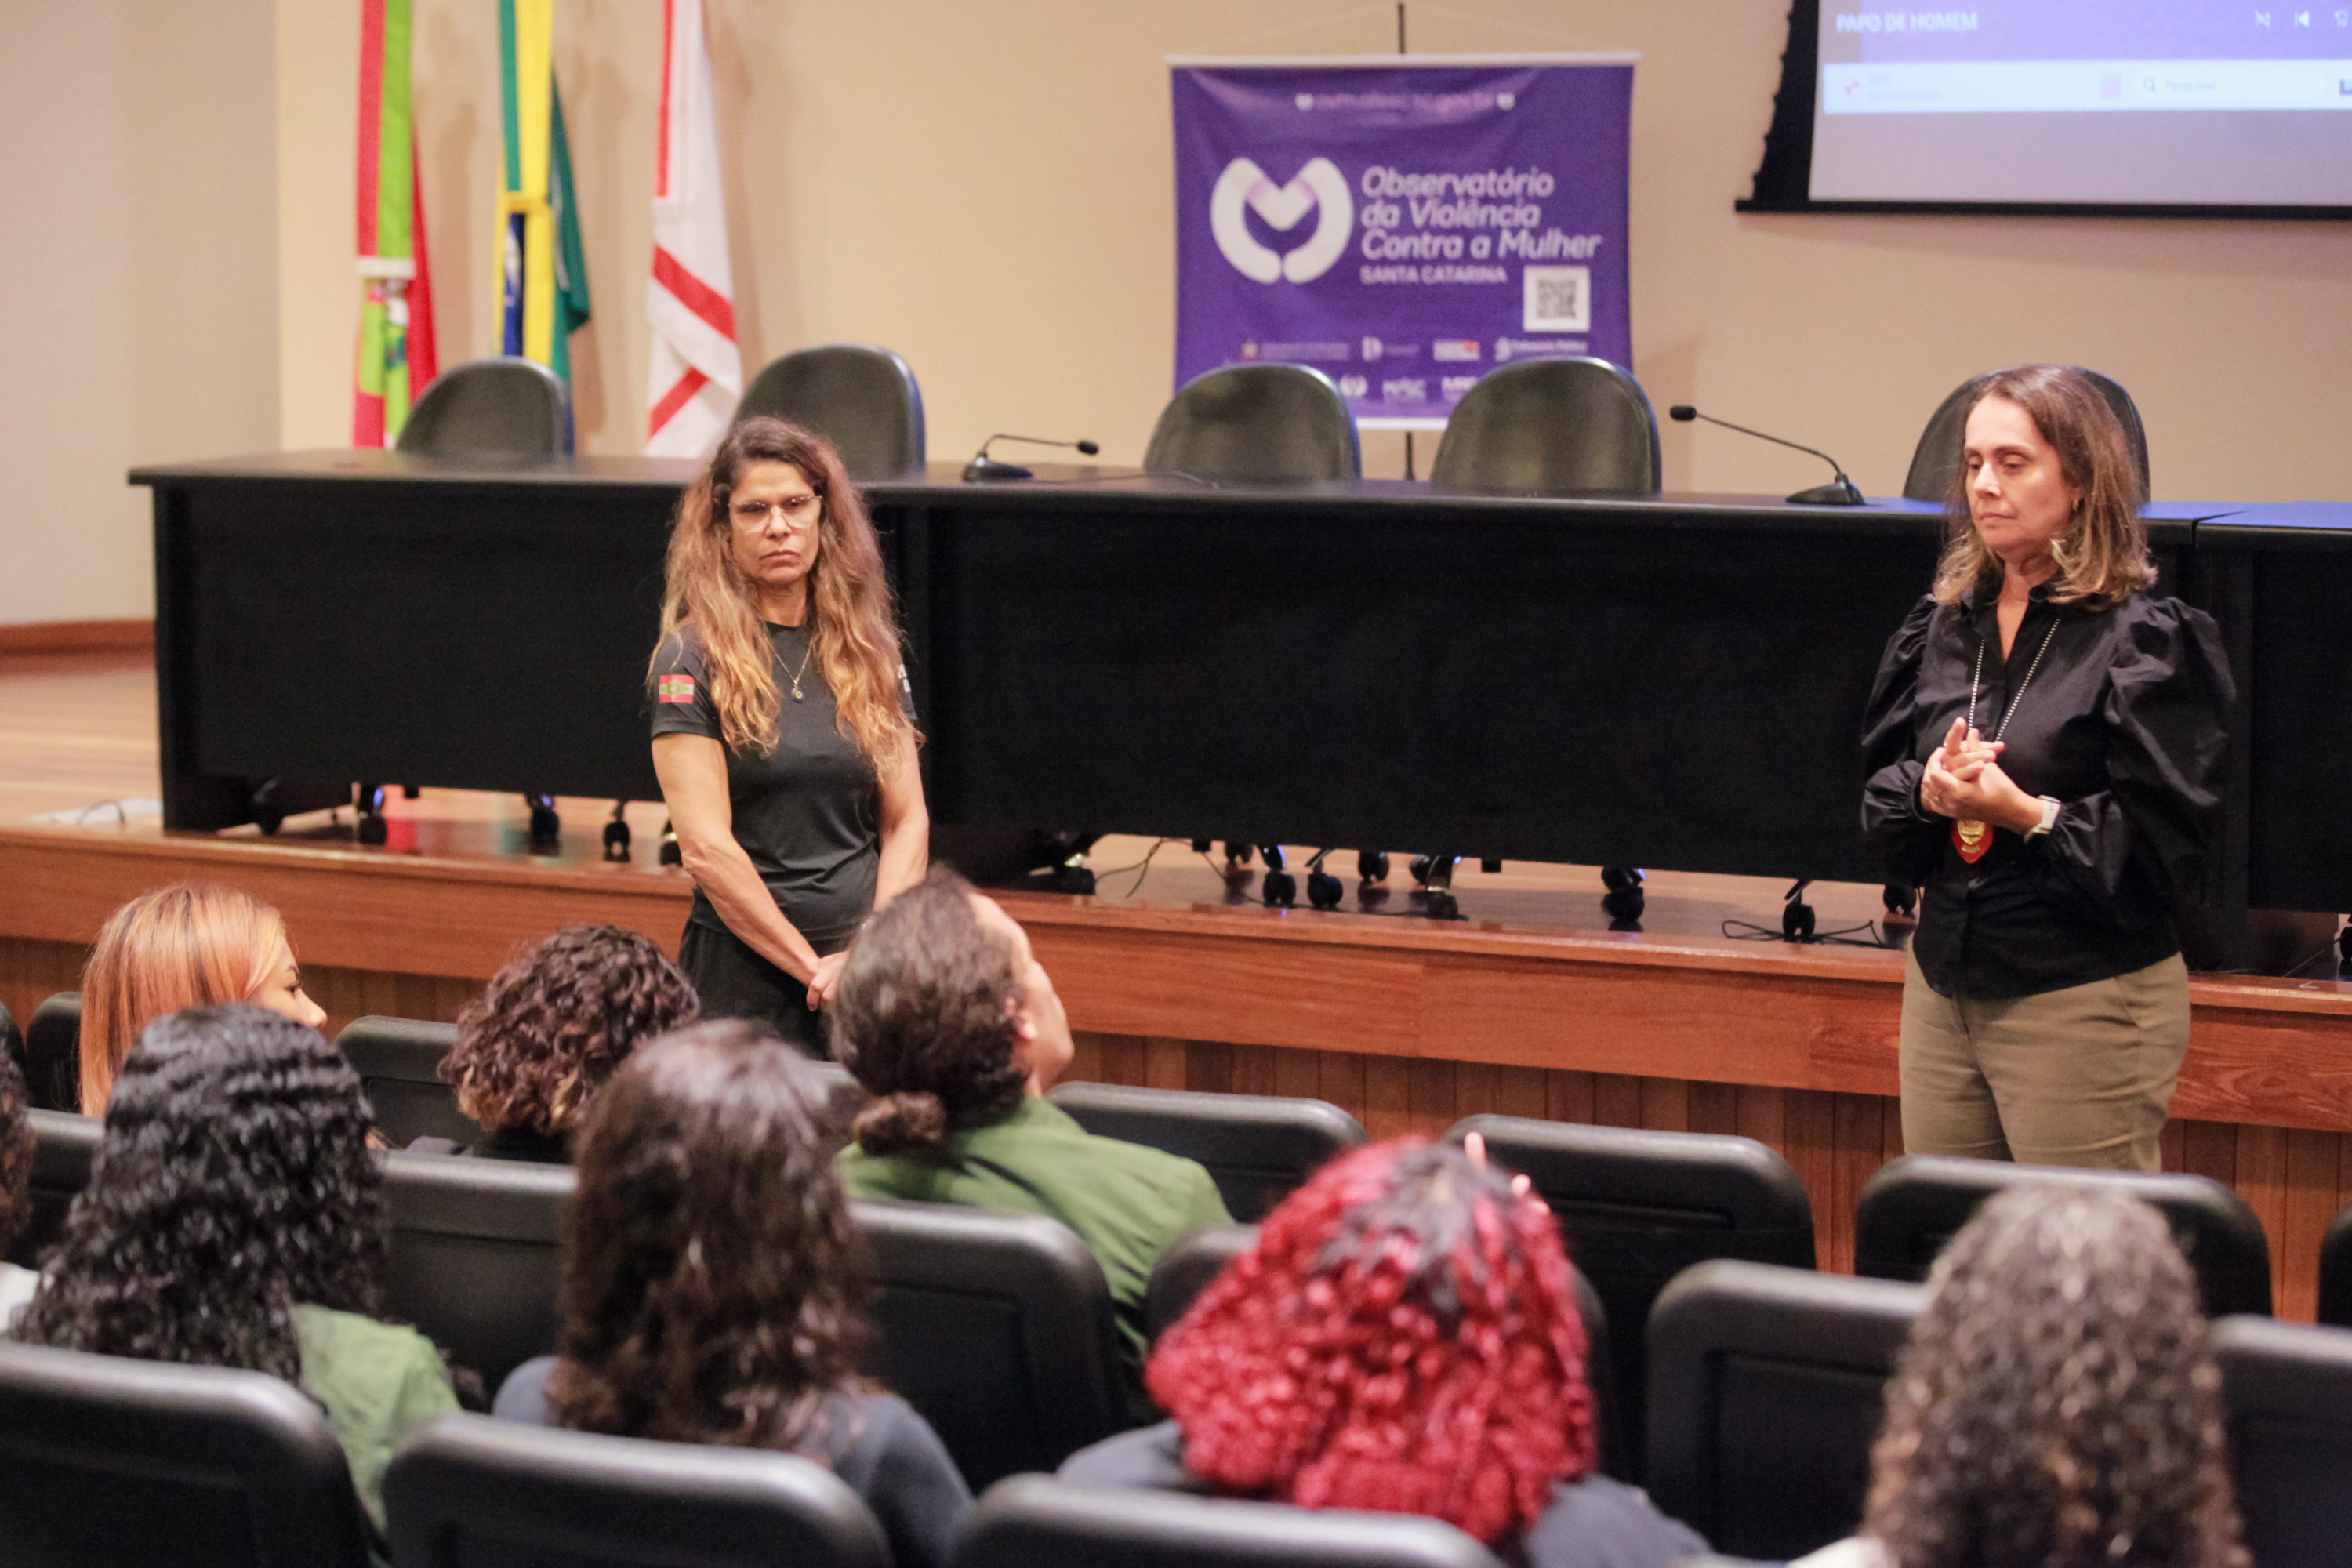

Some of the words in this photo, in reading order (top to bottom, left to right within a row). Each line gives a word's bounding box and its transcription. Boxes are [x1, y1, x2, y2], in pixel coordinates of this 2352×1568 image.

[1837, 13, 1881, 32] PAPO
[1884, 12, 1905, 32] DE
[1910, 11, 1978, 31] HOMEM
[1361, 165, 1555, 198] Observatório
[1361, 199, 1400, 229] da
[1410, 198, 1541, 228] Violência
[1361, 227, 1465, 260] Contra
[1470, 235, 1491, 260] a
[1497, 227, 1603, 260] Mulher
[1360, 265, 1421, 285] SANTA
